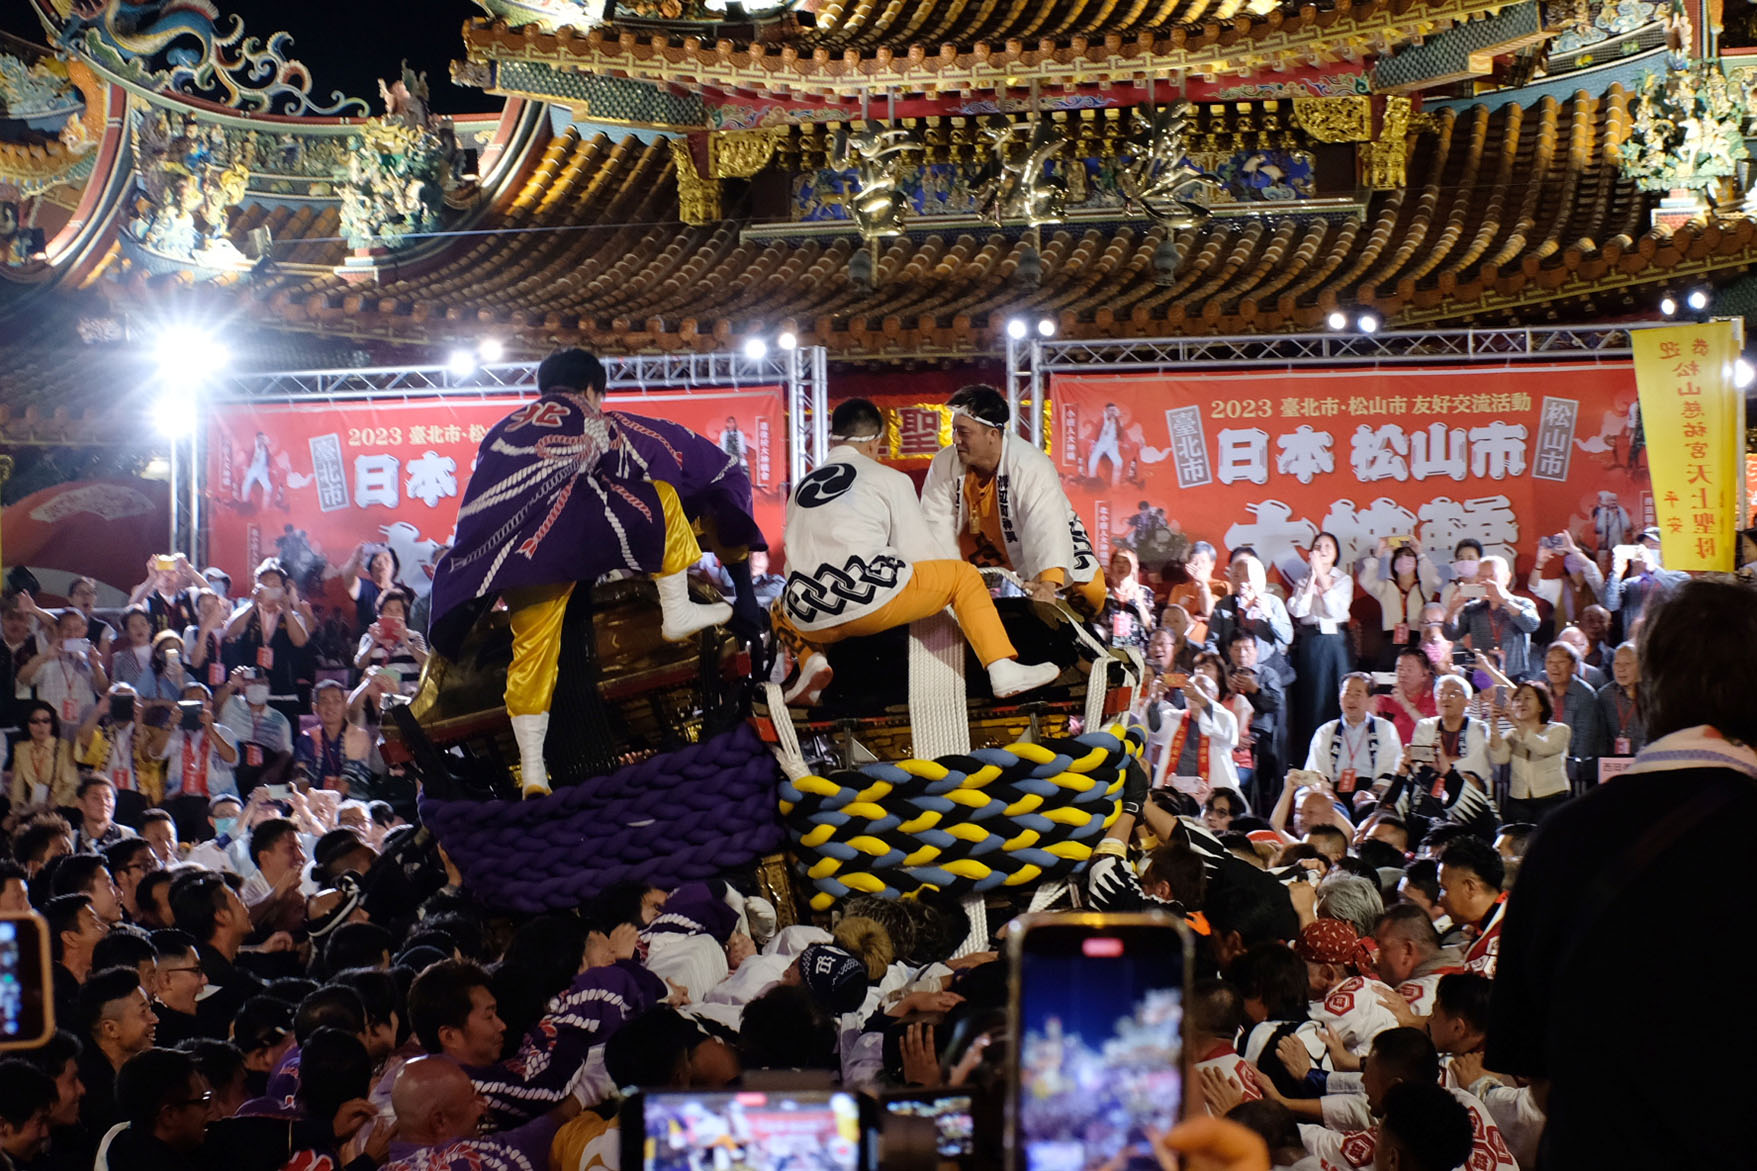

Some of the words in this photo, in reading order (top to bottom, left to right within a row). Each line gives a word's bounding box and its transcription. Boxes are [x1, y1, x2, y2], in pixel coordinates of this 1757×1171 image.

[504, 401, 571, 432] 北
[1210, 399, 1272, 418] 2023
[1411, 392, 1532, 415] 友好交流活動
[348, 426, 403, 447] 2023
[1170, 411, 1206, 483] 臺北市
[1215, 424, 1335, 485] 日本
[1350, 420, 1529, 482] 松山市
[1541, 402, 1573, 476] 松山市
[353, 450, 458, 510] 日本
